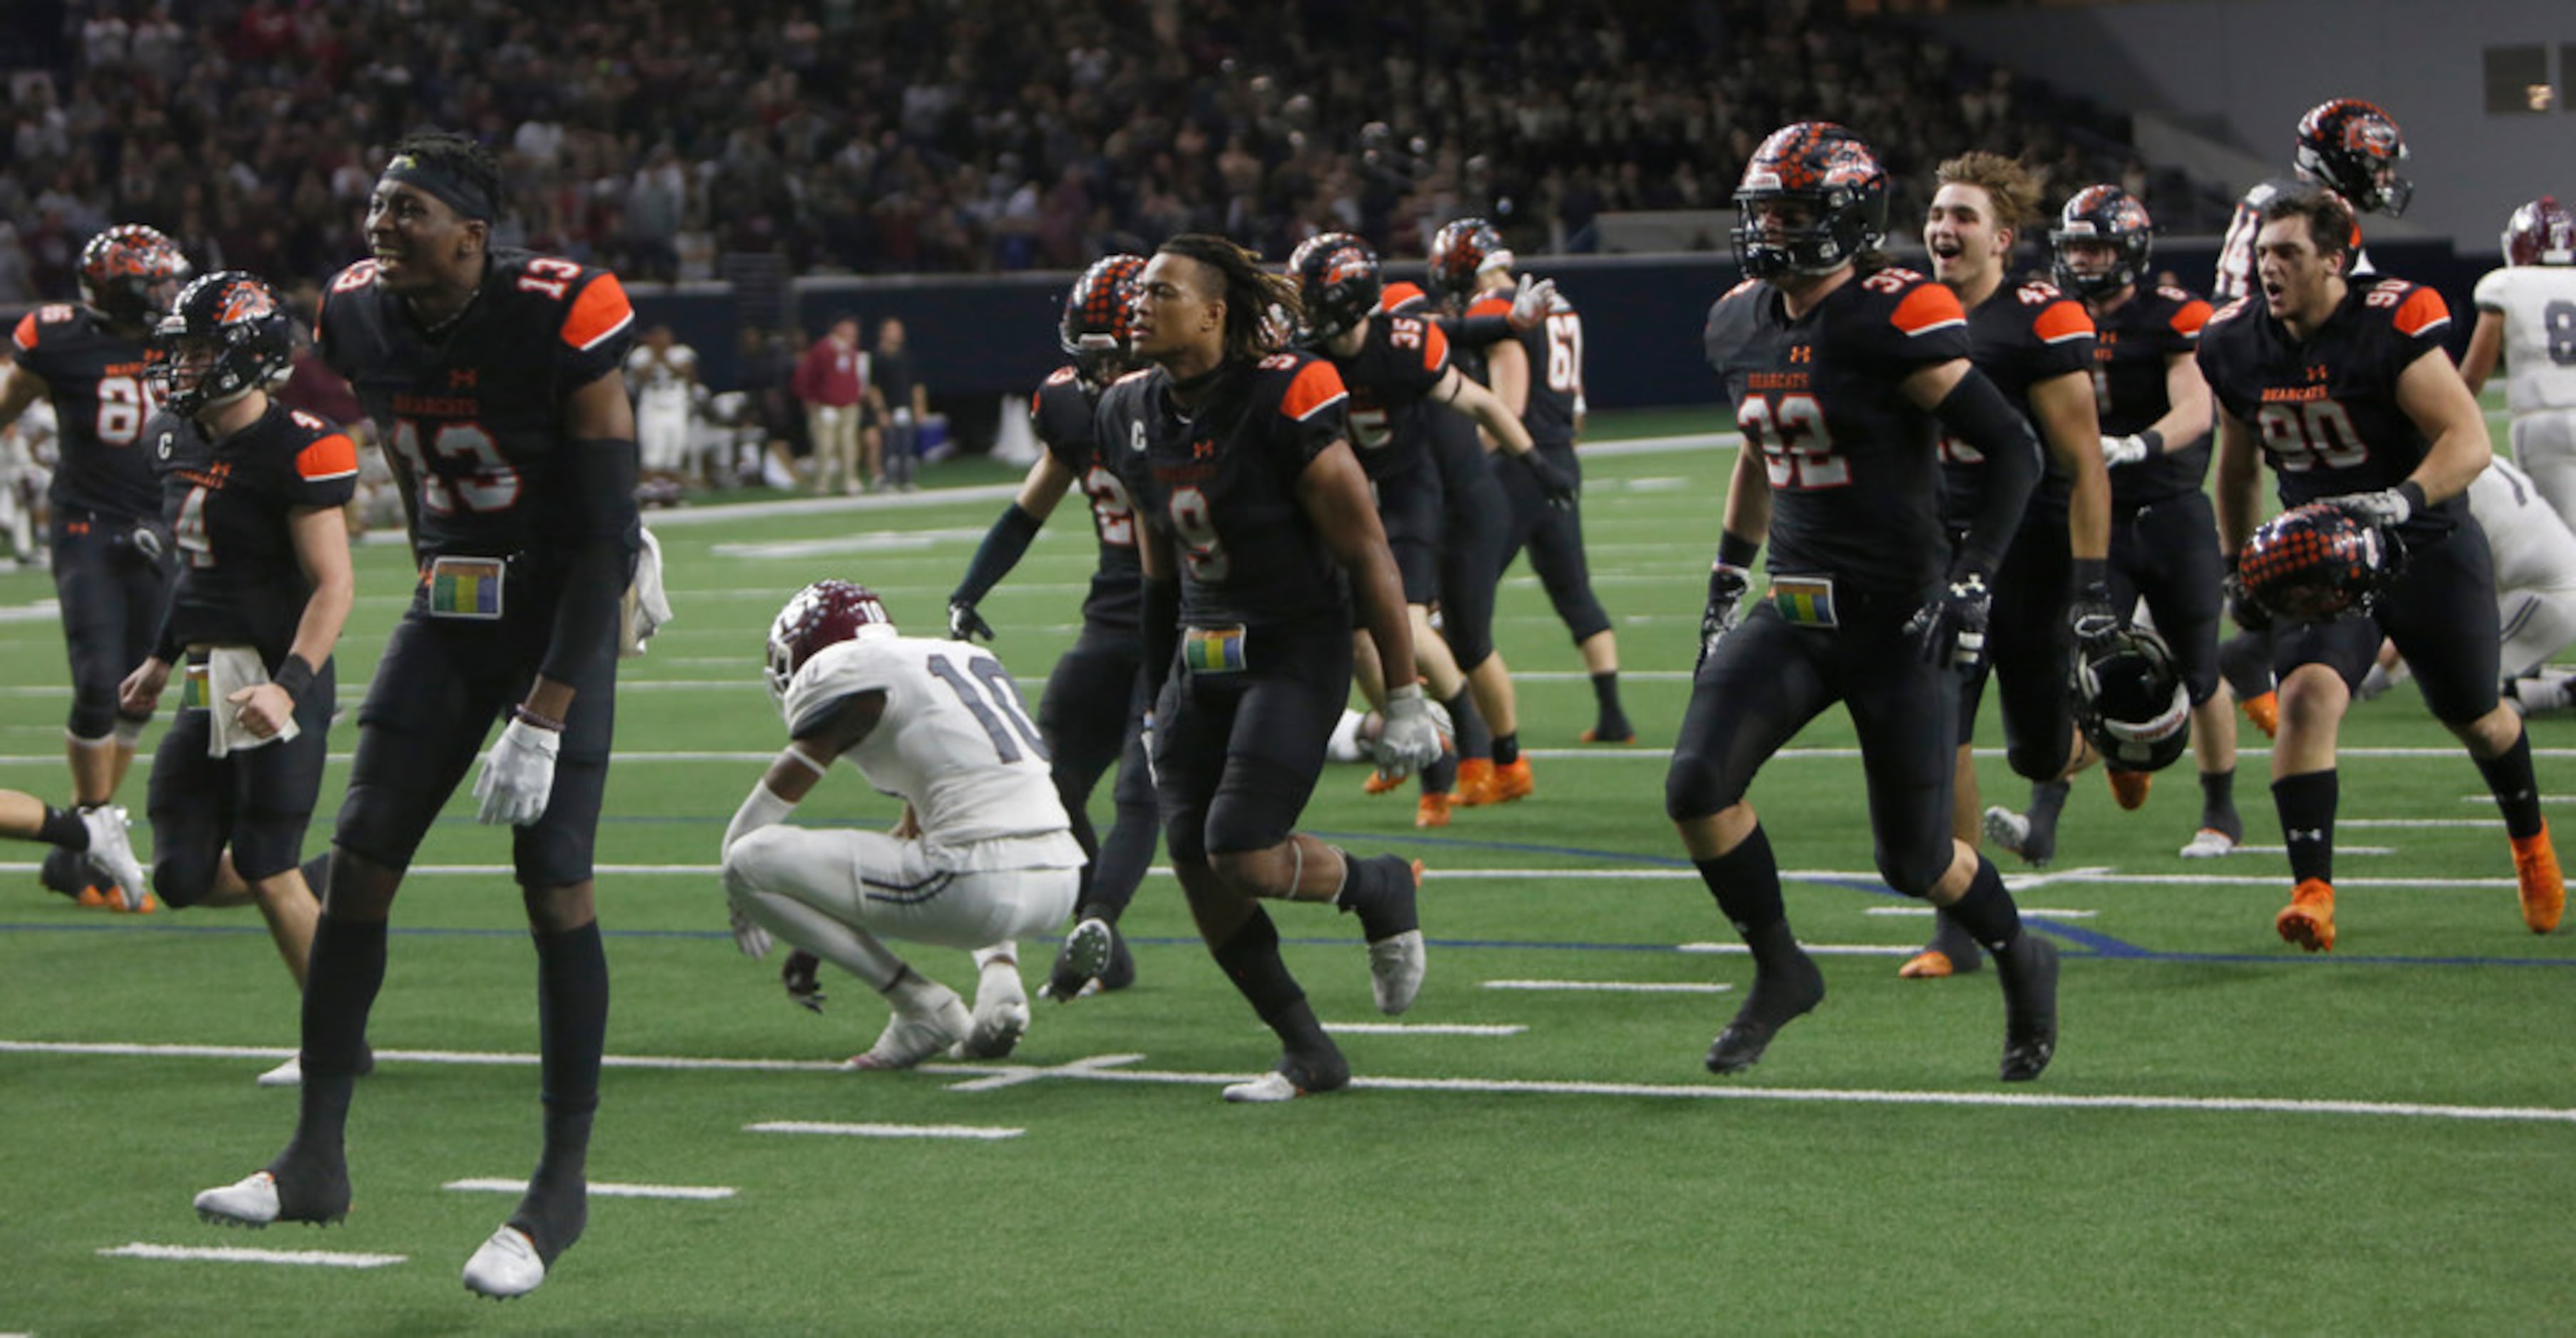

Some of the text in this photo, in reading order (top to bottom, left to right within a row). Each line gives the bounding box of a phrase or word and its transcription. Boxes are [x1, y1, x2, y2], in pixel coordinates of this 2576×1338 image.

[518, 256, 581, 301] 13
[2365, 278, 2411, 308] 90
[1390, 318, 1423, 349] 35
[1546, 311, 1583, 391] 67
[1748, 373, 1809, 388] BEARCATS
[2261, 385, 2328, 401] BEARCATS
[157, 431, 172, 460] C
[1131, 419, 1147, 452] C
[1737, 393, 1852, 489] 32
[2257, 400, 2371, 472] 90
[394, 418, 522, 512] 13
[175, 483, 216, 567] 4
[1169, 485, 1231, 582] 9
[926, 653, 1051, 764] 10
